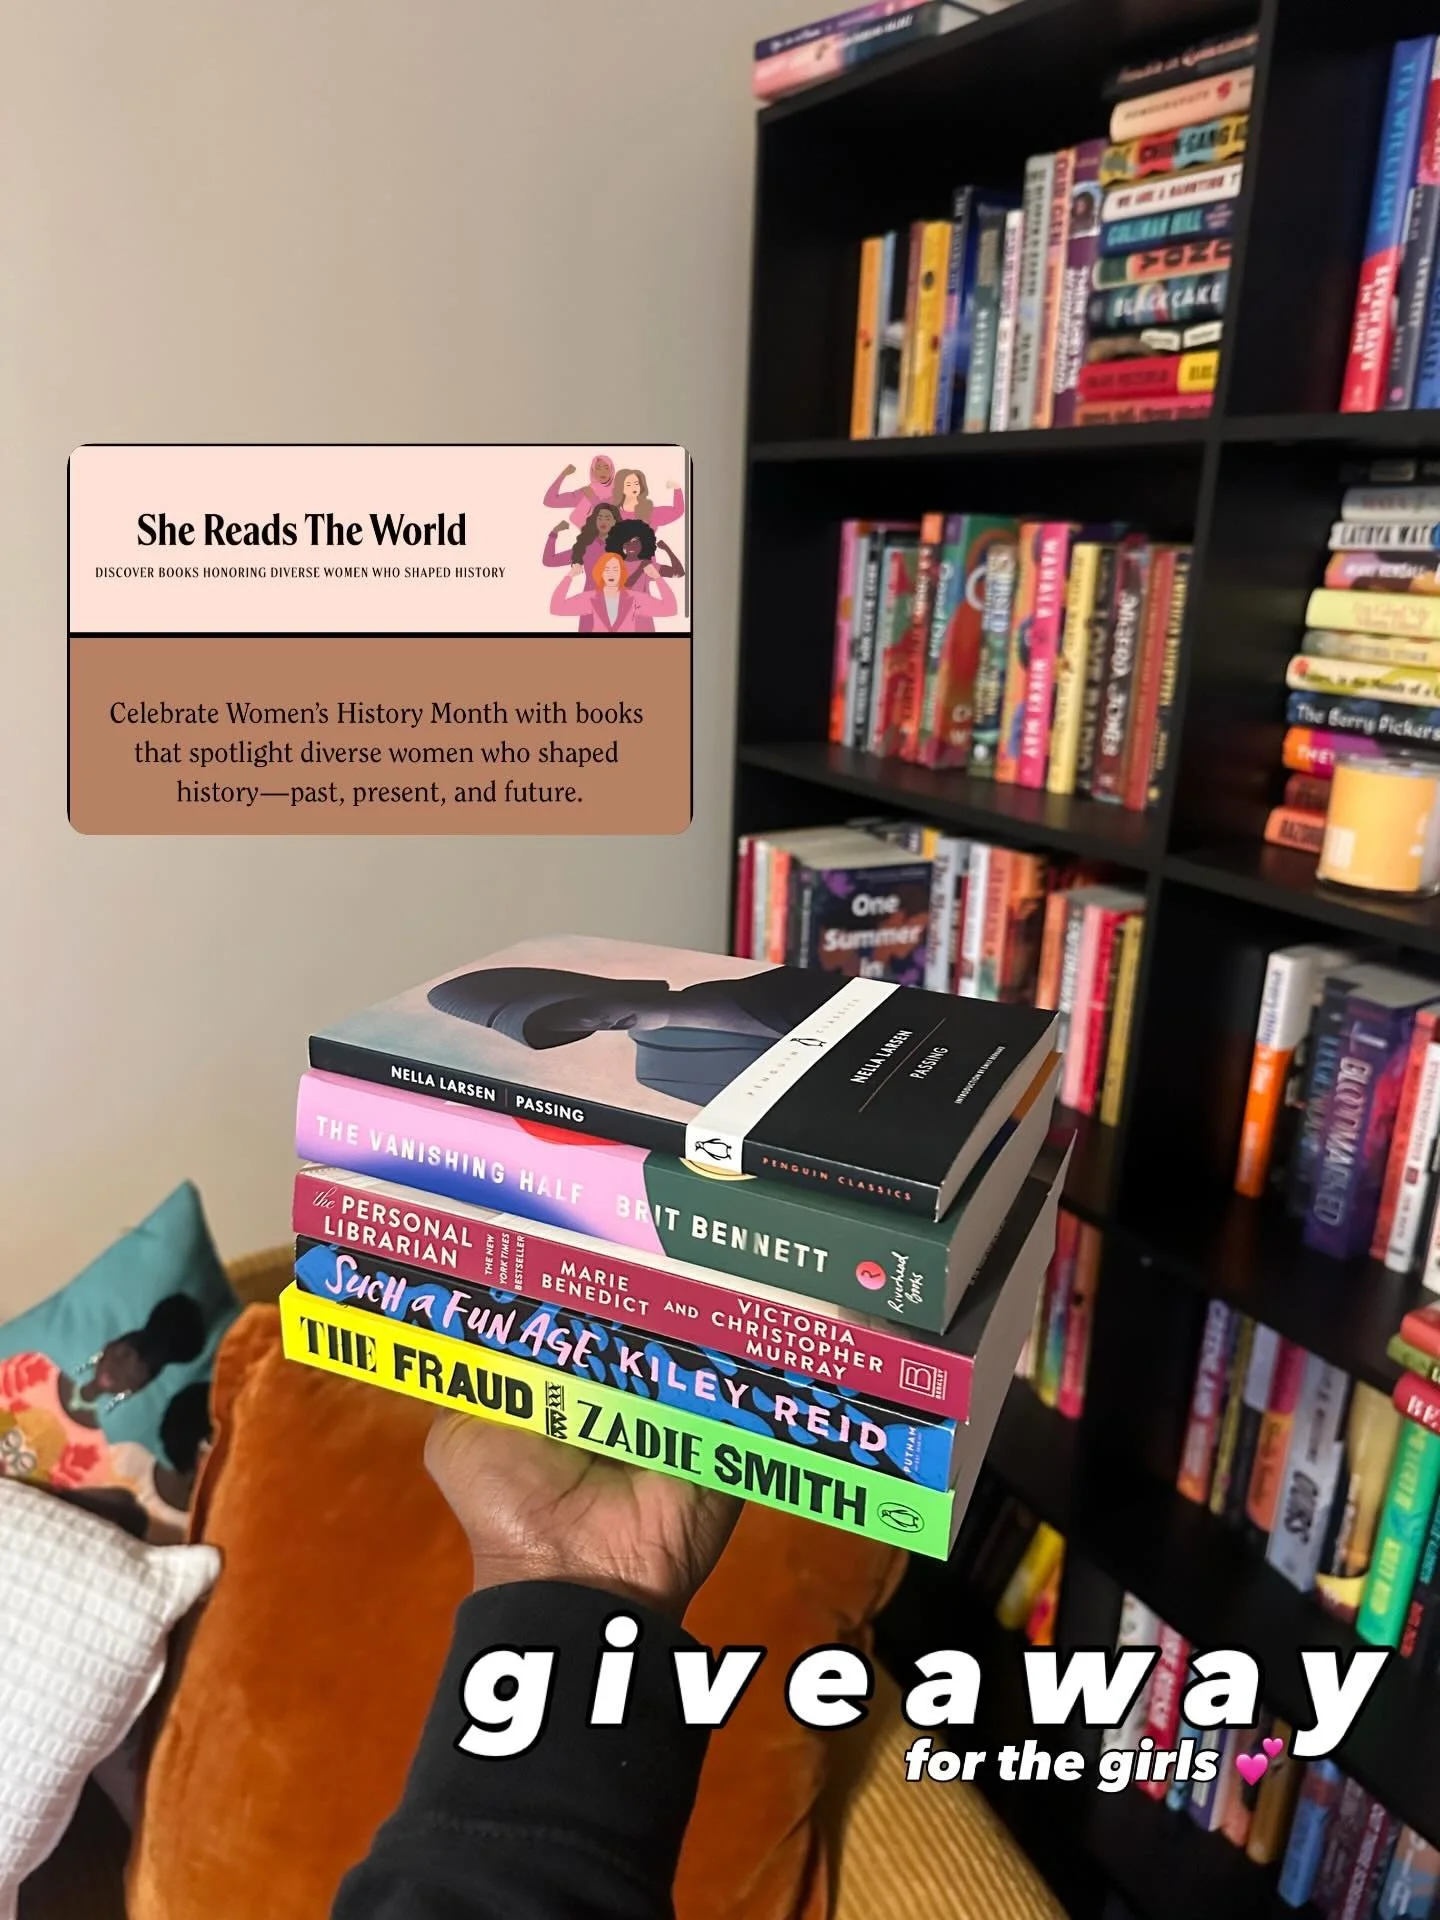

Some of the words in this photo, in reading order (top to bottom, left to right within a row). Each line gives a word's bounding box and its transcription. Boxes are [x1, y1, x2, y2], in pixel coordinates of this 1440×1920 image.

[1171, 282, 1224, 311] CAKE
[1296, 702, 1325, 725] The
[1328, 706, 1378, 735] Berry
[1378, 714, 1440, 742] Pickers
[852, 892, 900, 917] One
[823, 924, 925, 952] Summer
[850, 1056, 886, 1084] NELLA
[876, 1029, 913, 1058] LARSEN
[909, 1047, 949, 1080] PASSING
[391, 1065, 435, 1088] NELLA
[440, 1077, 496, 1102] LARSEN
[516, 1095, 585, 1123] PASSING
[316, 1114, 359, 1146] THE
[369, 1129, 506, 1184] VANISHING
[519, 1169, 585, 1205] HALF
[614, 1194, 681, 1233] BRIT
[691, 1215, 829, 1273] BENNETT
[761, 1156, 829, 1181] PENGUIN
[837, 1174, 912, 1202] CLASSICS
[312, 1186, 336, 1210] the
[342, 1195, 473, 1249] PERSONAL
[324, 1216, 458, 1269] LIBRARIAN
[484, 1256, 494, 1275] THE
[485, 1234, 495, 1256] NEW
[500, 1232, 510, 1259] TIMES
[514, 1235, 525, 1291] BESTSELLER
[499, 1259, 509, 1285] YORK
[560, 1260, 630, 1292] MARIE
[887, 1251, 911, 1314] Riverhead
[904, 1272, 924, 1304] Books
[541, 1274, 649, 1316] BENEDICT
[663, 1300, 699, 1320] AND
[711, 1312, 884, 1374] CHRISTOPHER
[737, 1299, 856, 1347] VICTORIA
[518, 1312, 602, 1368] AGE
[619, 1346, 752, 1410] KILEY
[774, 1394, 888, 1453] REID
[745, 1340, 848, 1382] MURRAY
[300, 1316, 377, 1374] THE
[393, 1343, 534, 1421] FRAUD
[577, 1400, 703, 1476] ZADIE
[714, 1442, 867, 1528] SMITH
[903, 1426, 917, 1473] PUTNAM
